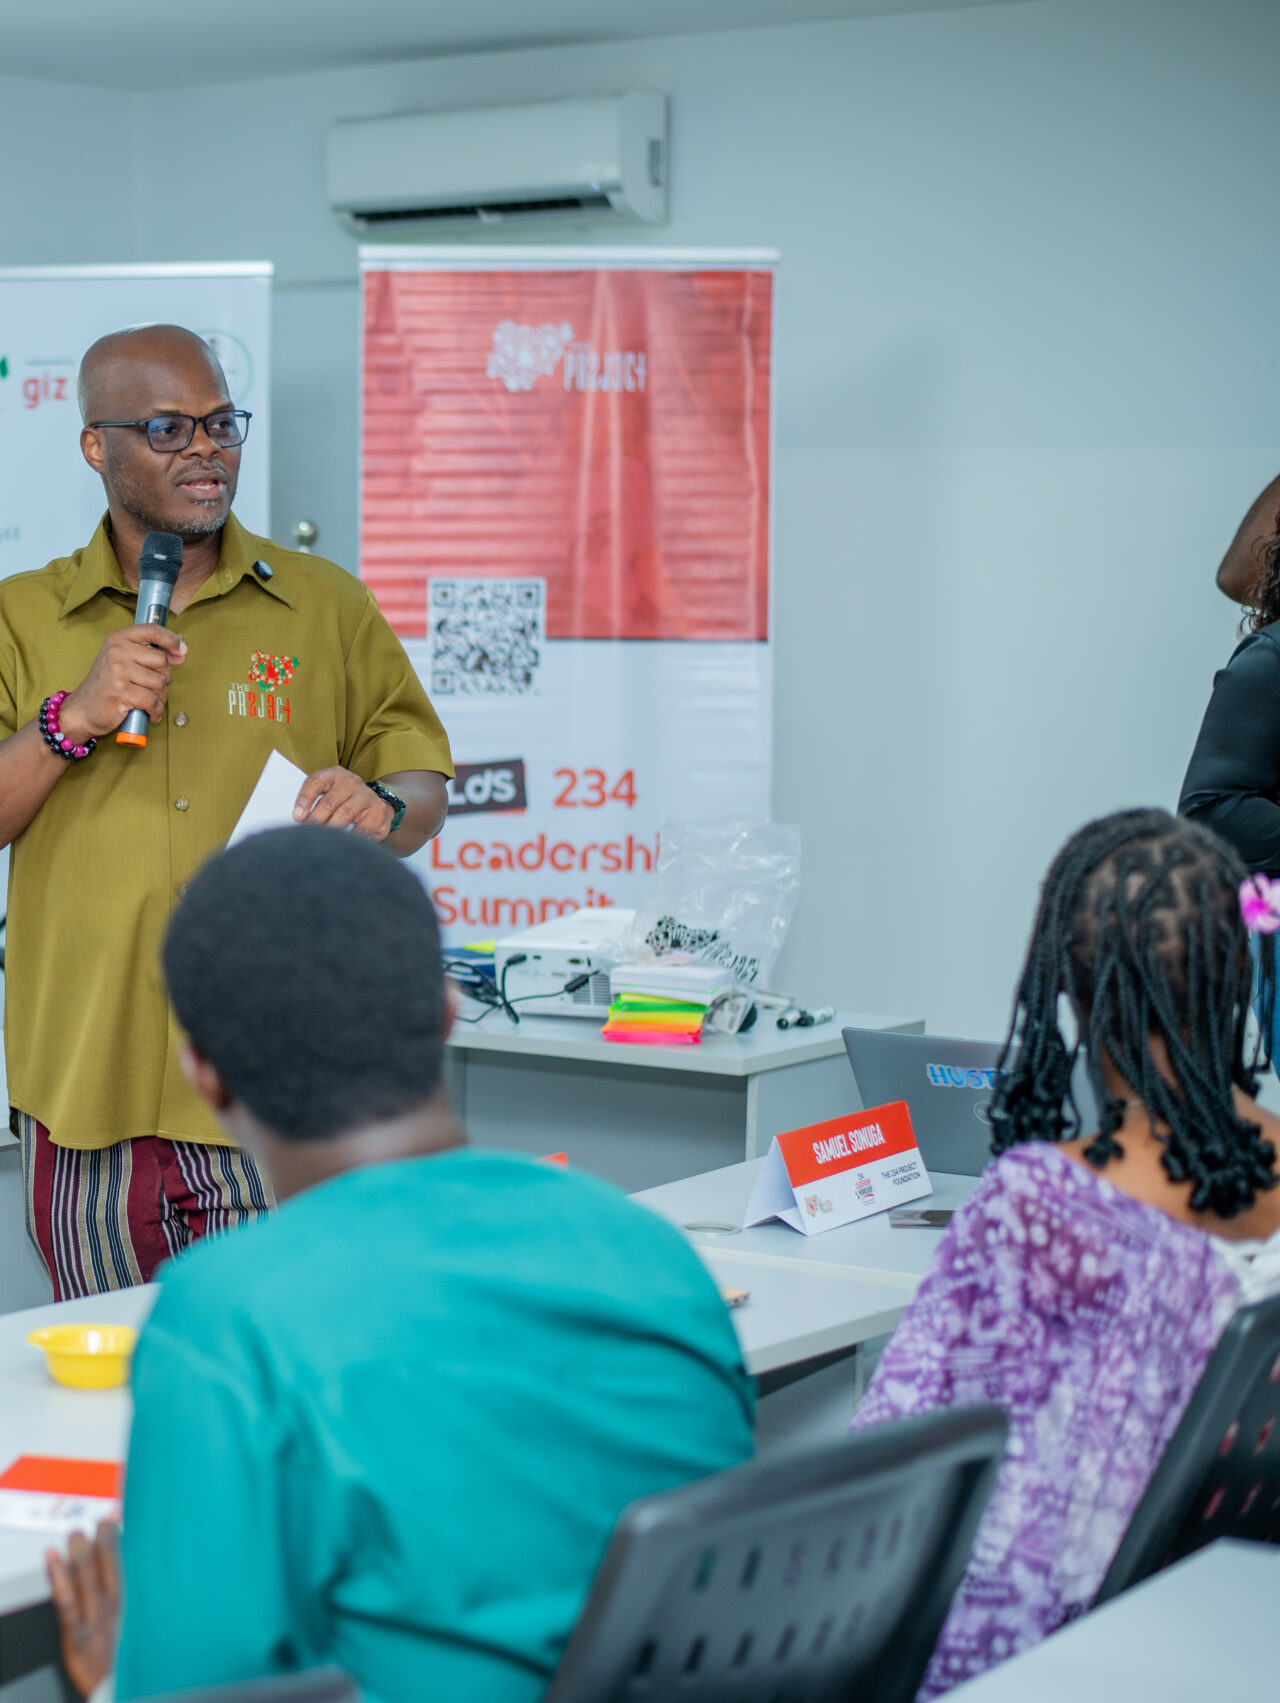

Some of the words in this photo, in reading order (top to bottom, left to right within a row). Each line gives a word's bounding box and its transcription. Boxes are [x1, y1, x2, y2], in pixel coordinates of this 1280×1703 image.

[22, 371, 68, 410] giz
[231, 682, 250, 692] THE
[553, 768, 638, 808] 234
[431, 833, 660, 873] Leadershi
[929, 1065, 1004, 1089] HUST
[812, 1134, 851, 1164] SAMUEL
[848, 1123, 885, 1153] SONUGA
[892, 1172, 921, 1185] FOUNDATION
